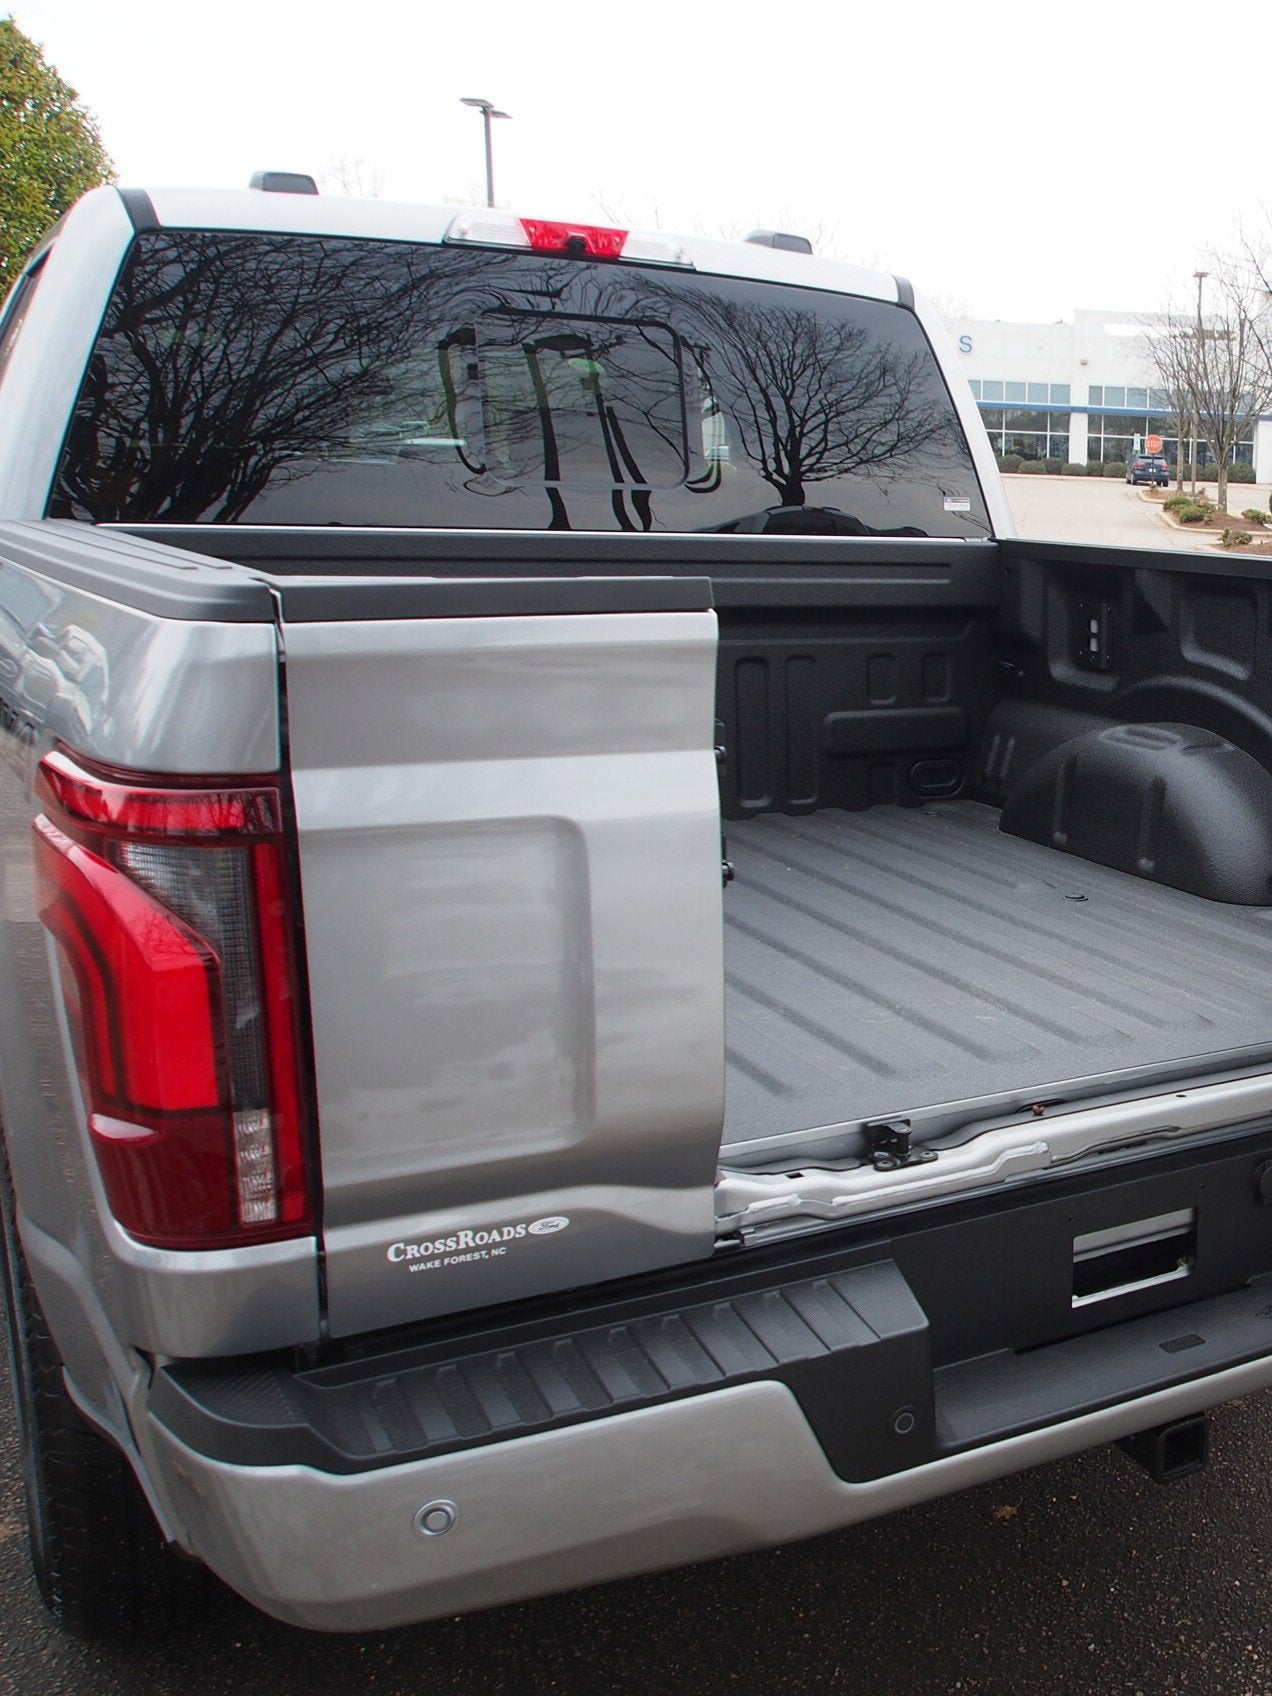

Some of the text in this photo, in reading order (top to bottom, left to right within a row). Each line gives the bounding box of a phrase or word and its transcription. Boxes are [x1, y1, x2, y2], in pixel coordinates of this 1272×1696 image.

[409, 1246, 507, 1272] WAKE FOREST, NC
